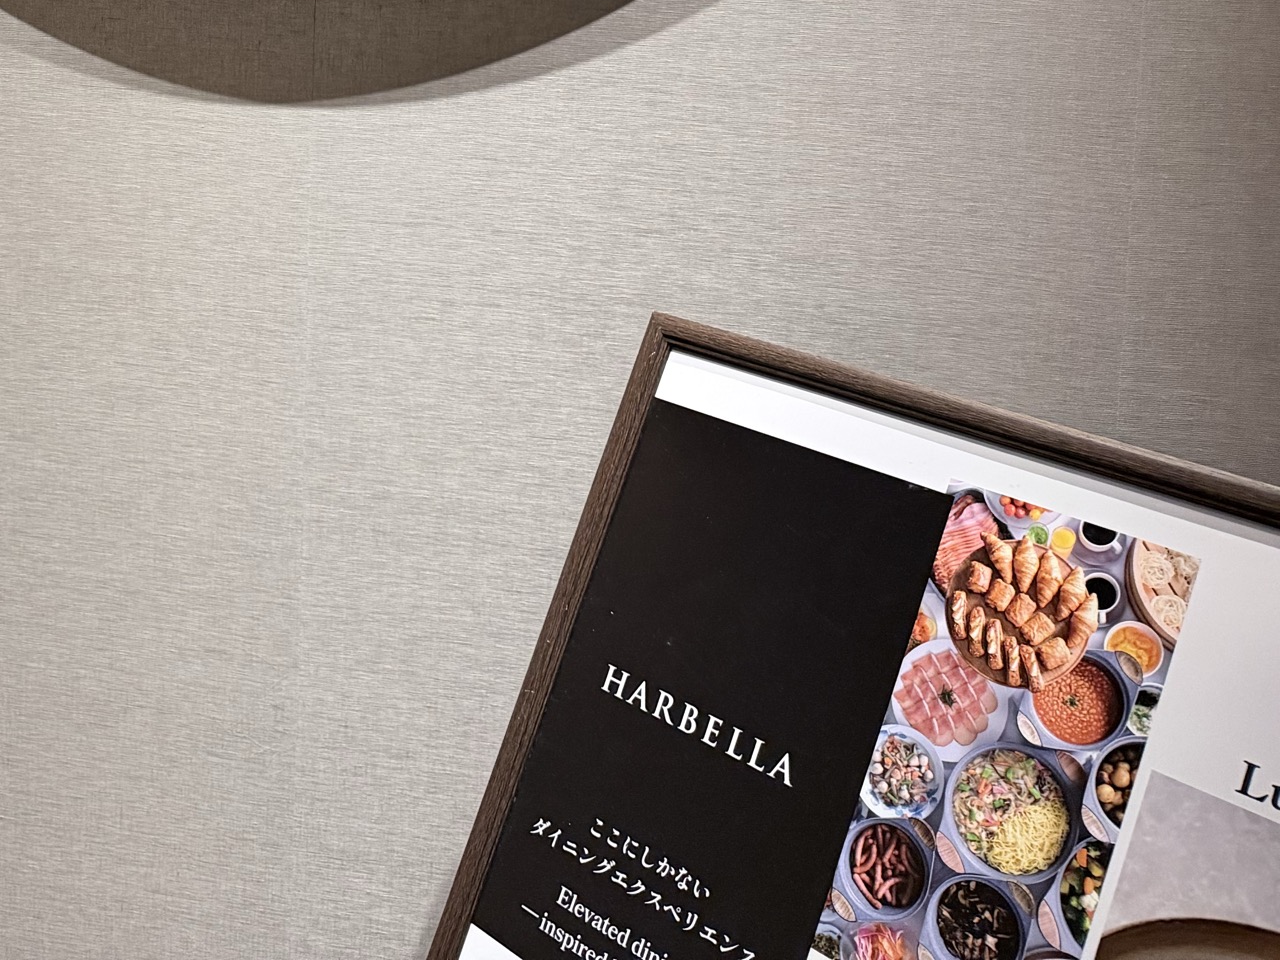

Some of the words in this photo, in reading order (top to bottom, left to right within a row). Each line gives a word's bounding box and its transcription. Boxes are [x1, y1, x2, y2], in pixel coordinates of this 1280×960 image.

[601, 663, 793, 788] HARBELLA
[1234, 760, 1280, 811] L
[590, 818, 710, 898] ここにしかない
[556, 885, 631, 948] Elevated
